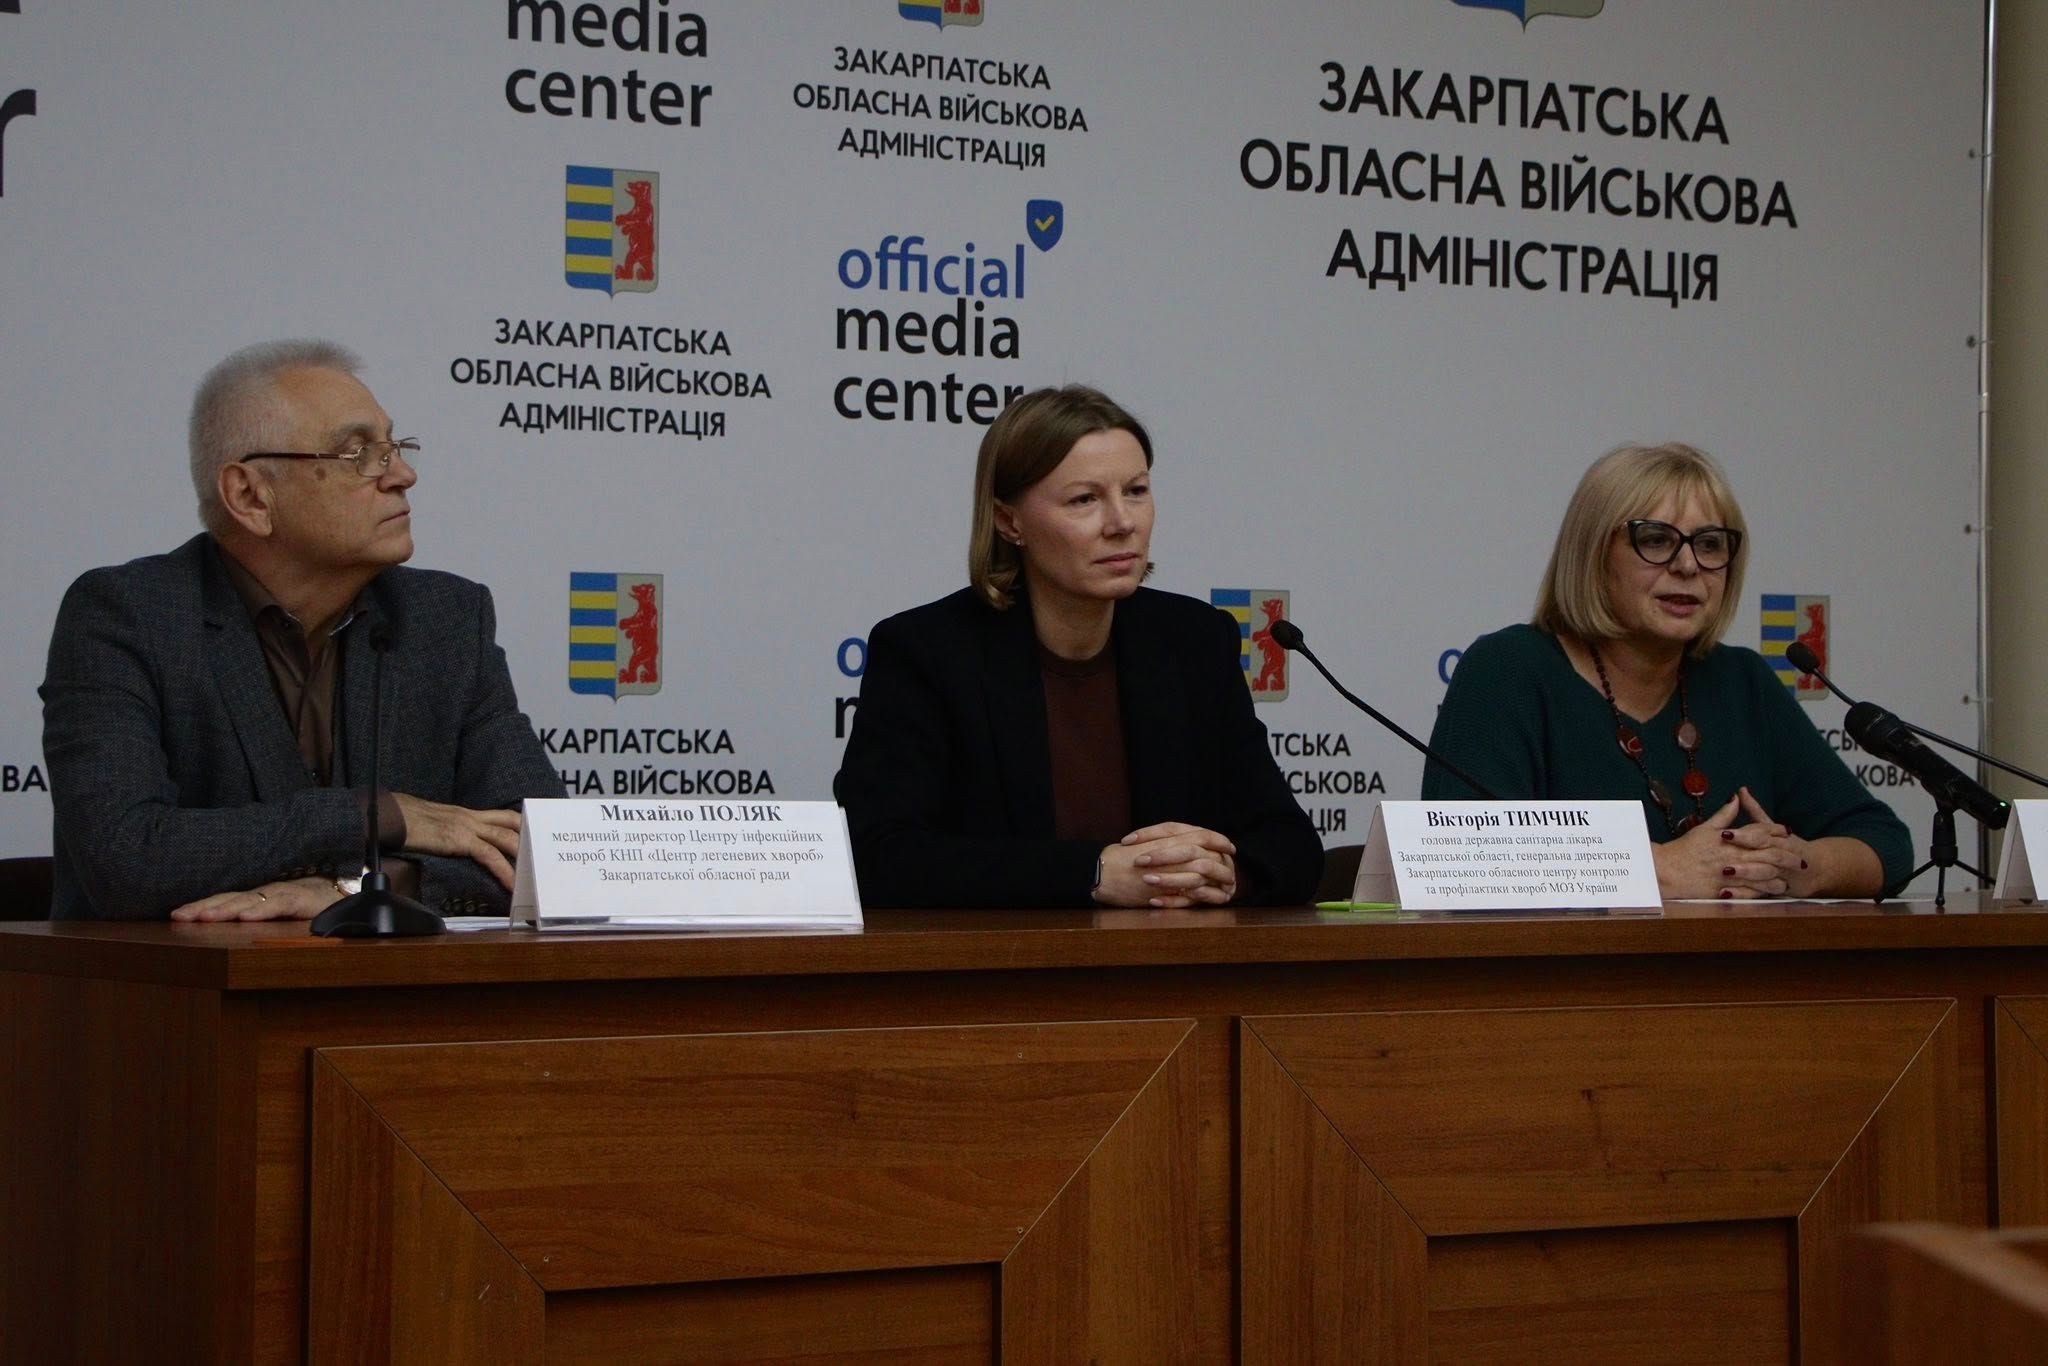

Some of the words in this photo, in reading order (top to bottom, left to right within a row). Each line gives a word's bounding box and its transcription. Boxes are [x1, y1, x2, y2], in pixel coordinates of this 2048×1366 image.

[508, 0, 707, 57] media
[833, 46, 1051, 90] ЗАКАРПАТСЬКА
[505, 68, 712, 127] center
[793, 83, 932, 120] ОБЛАСНА
[939, 90, 1088, 132] ВІЙСЬКОВА
[1319, 61, 1730, 145] ЗАКАРПАТСЬКА
[838, 128, 1046, 170] АДМІНІСТРАЦІЯ
[1240, 139, 1506, 208] ОБЛАСНА
[1521, 155, 1798, 229] ВІЙСЬКОВА
[838, 235, 1024, 298] official
[1326, 229, 1718, 309] АДМІНІСТРАЦІЯ
[494, 318, 731, 356] ЗАКАРПАТСЬКА
[837, 297, 1019, 359] media
[450, 358, 601, 390] ОБЛАСНА
[610, 363, 772, 399] ВІЙСЬКОВА
[499, 402, 725, 441] АДМІНІСТРАЦІЯ
[613, 765, 775, 795] ВІЙСЬКОВА
[1281, 769, 1386, 794] СЬКОВА
[600, 804, 694, 821] Михайло
[699, 804, 783, 821] ПОЛЯК
[1427, 811, 1500, 831] Вікторія
[1503, 811, 1590, 826] ТИМЧИК
[552, 830, 620, 842] медичний
[624, 832, 686, 845] директор
[690, 830, 738, 845] Центру
[742, 830, 824, 845] інфекційних
[558, 849, 606, 864] хвороб
[610, 849, 643, 861] КНП
[648, 848, 697, 864] «Центр
[701, 852, 767, 861] легеневих
[771, 848, 824, 864] хвороб»
[1421, 837, 1462, 845] головна
[1465, 836, 1513, 847] державна
[1516, 834, 1564, 847] санітарна
[1567, 834, 1603, 847] лікарка
[599, 868, 694, 884] Закарпатської
[698, 868, 756, 881] обласної
[760, 871, 791, 883] ради
[1398, 851, 1471, 864] Закарпатської
[1473, 850, 1514, 862] області,
[1516, 853, 1572, 863] генеральна
[1574, 852, 1631, 862] директорка
[1407, 867, 1486, 880] Закарпатського
[1488, 867, 1540, 878] обласного
[1543, 869, 1577, 879] центру
[1580, 868, 1629, 879] контролю
[1425, 886, 1436, 895] та
[1438, 883, 1509, 896] профілактики
[1511, 883, 1547, 896] хвороб
[1549, 882, 1575, 894] МОЗ
[1577, 882, 1618, 895] України
